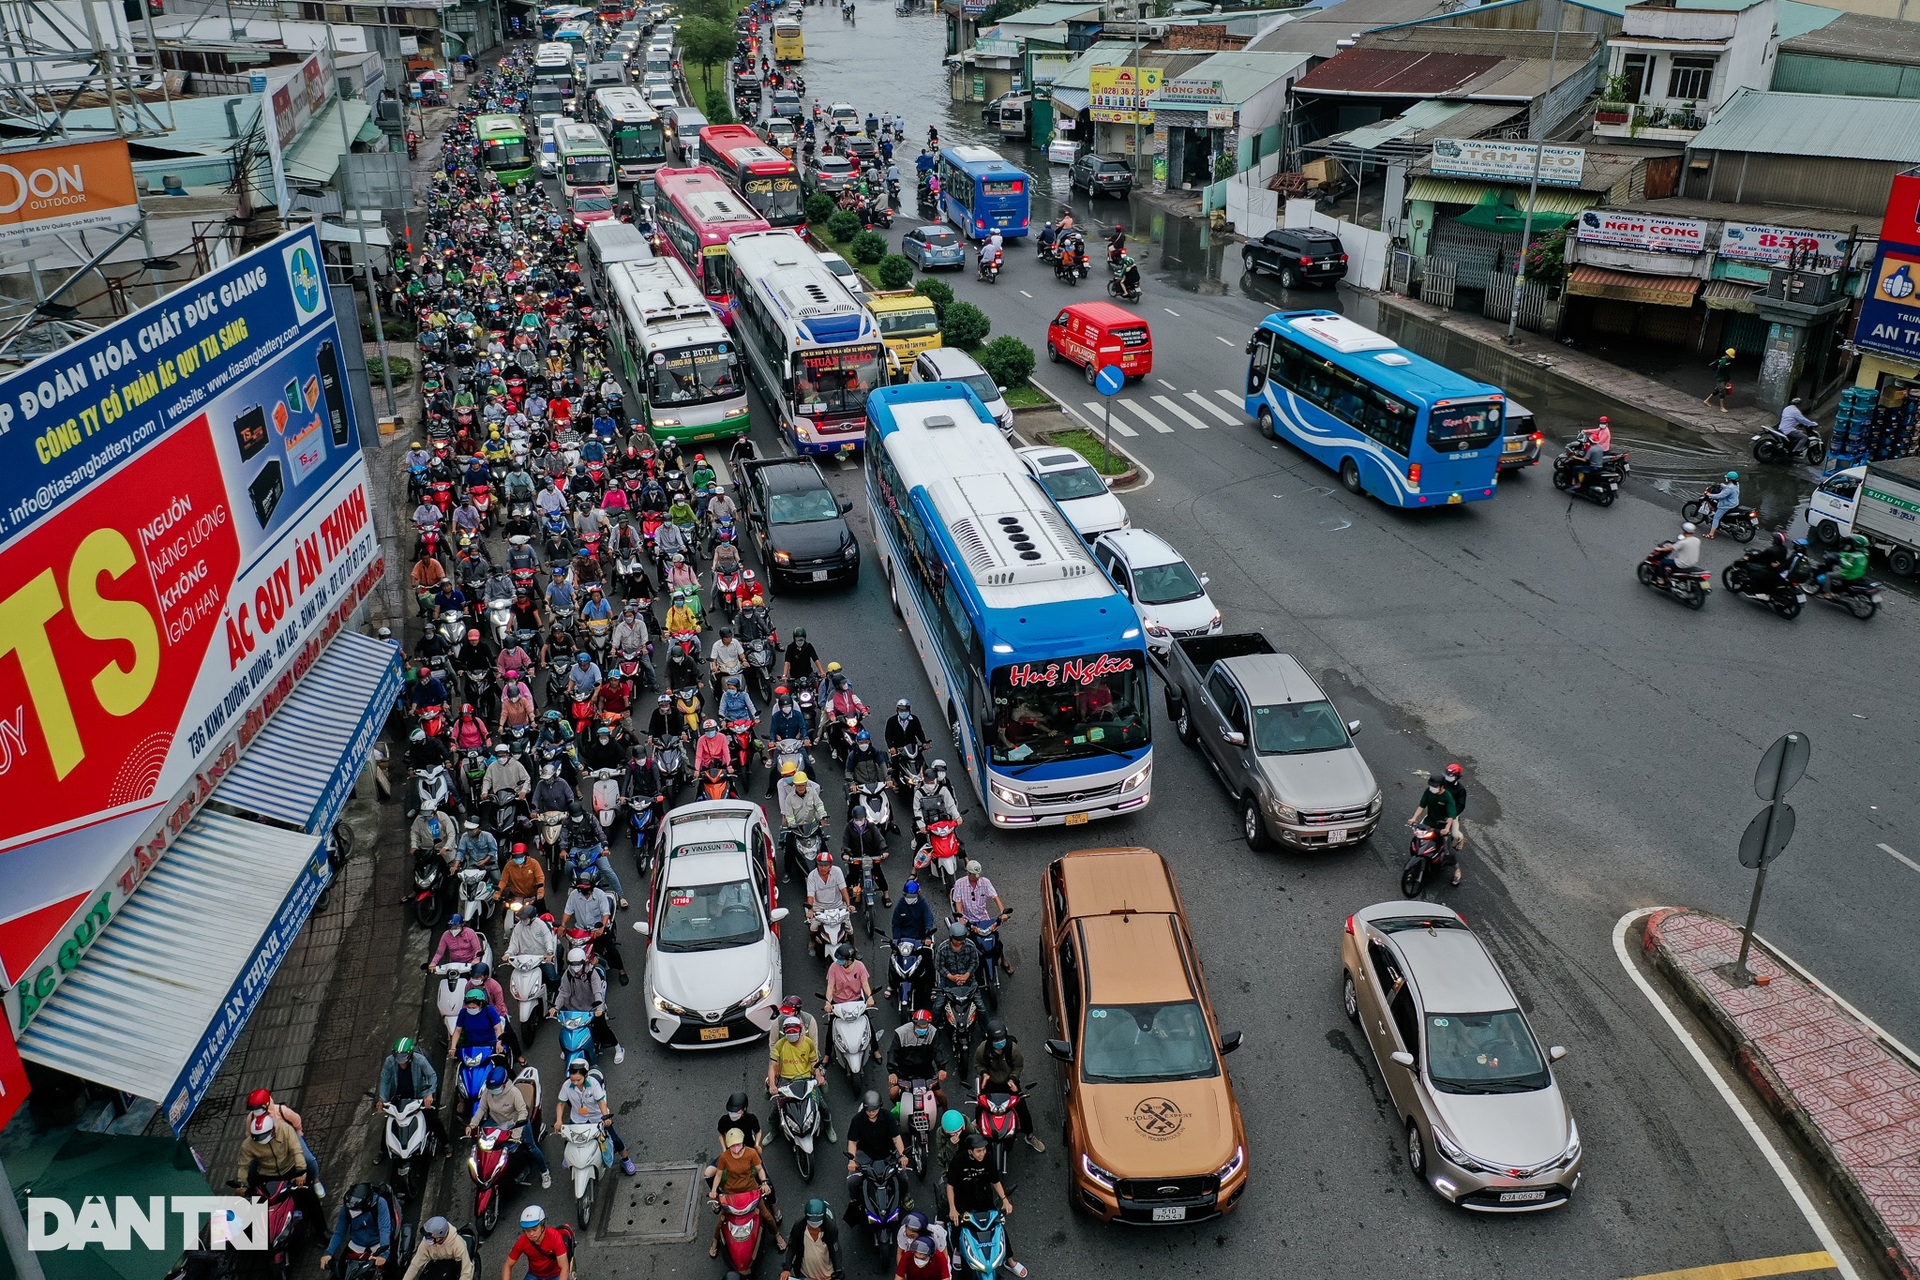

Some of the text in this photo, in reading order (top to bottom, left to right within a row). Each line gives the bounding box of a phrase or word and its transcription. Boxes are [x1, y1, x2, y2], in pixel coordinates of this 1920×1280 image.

[1102, 87, 1129, 95] (028) 36
[1485, 143, 1511, 151] HÀNG
[30, 194, 87, 210] OUTDOOR
[7, 228, 25, 236] TNHH
[1649, 225, 1699, 238] CÔNG
[19, 266, 267, 421] ĐOÀN HÓA CHẤT ĐỨC GIANG
[680, 347, 714, 359] XE BUÝT
[1871, 323, 1900, 341] AN
[667, 359, 684, 367] LONG
[802, 355, 839, 368] THUẬN
[35, 317, 249, 465] CÔNG TY CỔ PHẦN ẮC QUY TIA SÁNG
[8, 324, 300, 526] info@tiasangbattery.com website: www.tiasangbattery.com
[1867, 490, 1905, 507] SUZUKI
[142, 494, 192, 547] NGUỒN
[151, 504, 226, 580] NĂNG LƯỢNG
[160, 559, 209, 613] KHÔNG
[223, 483, 369, 672] ẮC QUY ÂN THỊNH
[169, 584, 220, 643] GIỚI HẠN
[0, 527, 160, 783] TS
[188, 725, 205, 760] 736
[204, 711, 226, 741] KINH
[223, 675, 250, 722] DƯƠNG
[249, 653, 274, 690] VƯƠNG
[275, 638, 287, 660] AN
[286, 620, 299, 648] LẠC
[300, 598, 317, 629] BÌNH
[315, 585, 328, 612] TÂN
[1010, 654, 1134, 686] Huệ Nghĩa
[340, 763, 354, 788] ÂN
[351, 715, 375, 765] THỊNH
[57, 891, 112, 975] QUY
[116, 827, 167, 896] TÂN
[292, 639, 321, 681] CHÀO
[692, 844, 721, 852] VINASUN
[188, 1063, 205, 1090] CÔNG
[224, 988, 245, 1032] ÂN
[242, 931, 281, 996] THỊNH
[1125, 1114, 1154, 1122] TOOLS
